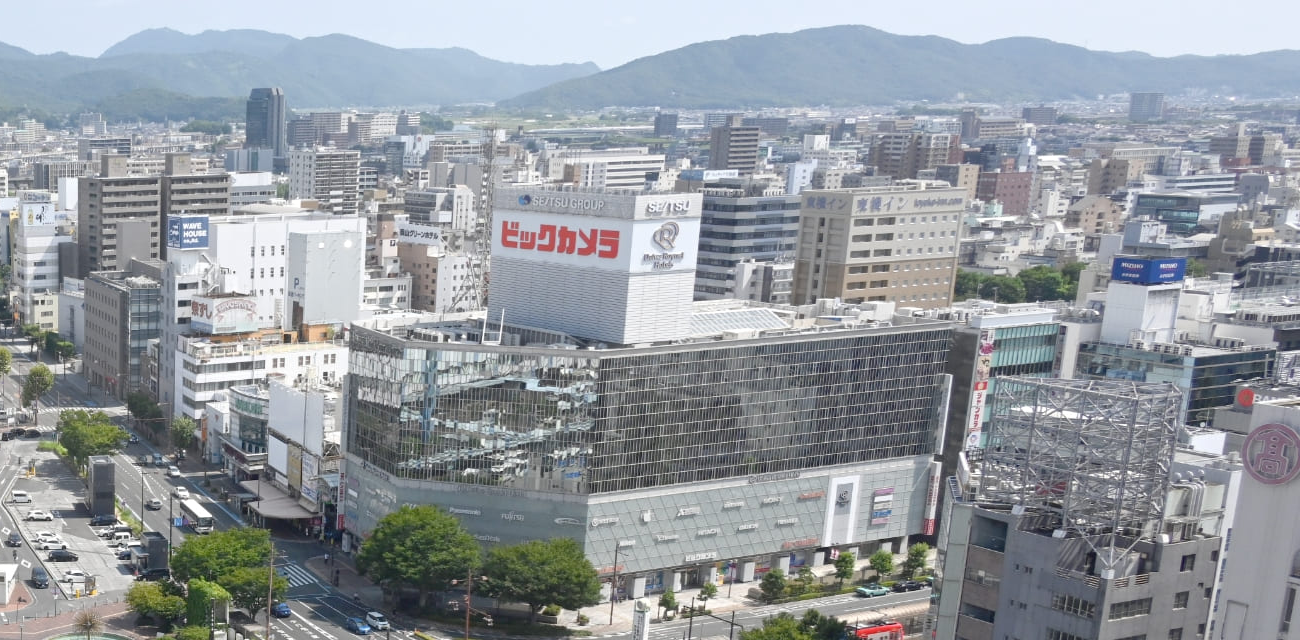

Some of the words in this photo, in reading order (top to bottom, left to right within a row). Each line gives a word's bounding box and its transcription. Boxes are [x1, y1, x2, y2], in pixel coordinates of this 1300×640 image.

[571, 199, 605, 210] GROUP
[856, 196, 909, 213] 東横イン
[501, 220, 620, 259] ビックカメラ
